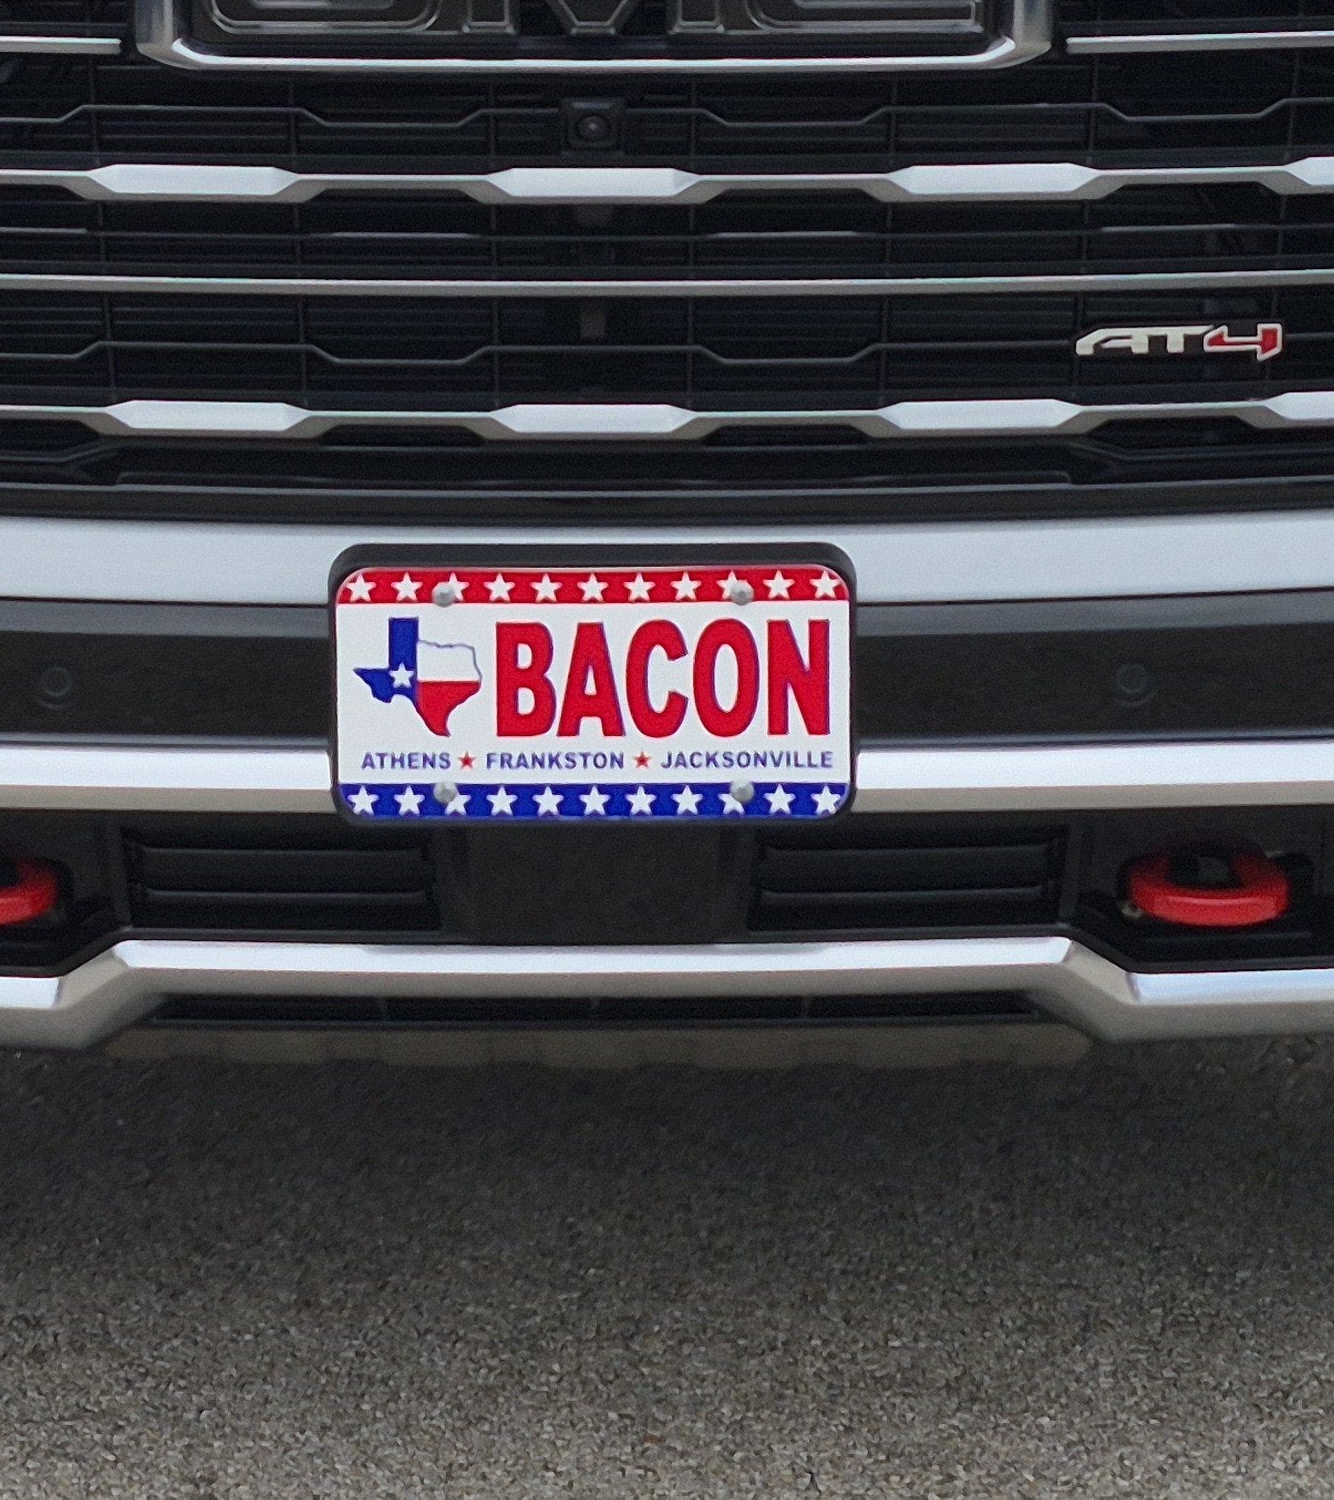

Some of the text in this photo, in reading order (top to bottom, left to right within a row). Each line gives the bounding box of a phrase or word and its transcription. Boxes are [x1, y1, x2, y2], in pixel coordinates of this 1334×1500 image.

[1075, 322, 1283, 362] AT4
[495, 618, 831, 738] BACON
[360, 750, 834, 771] ATHENS FRANKSTON JACKSONVILLE
